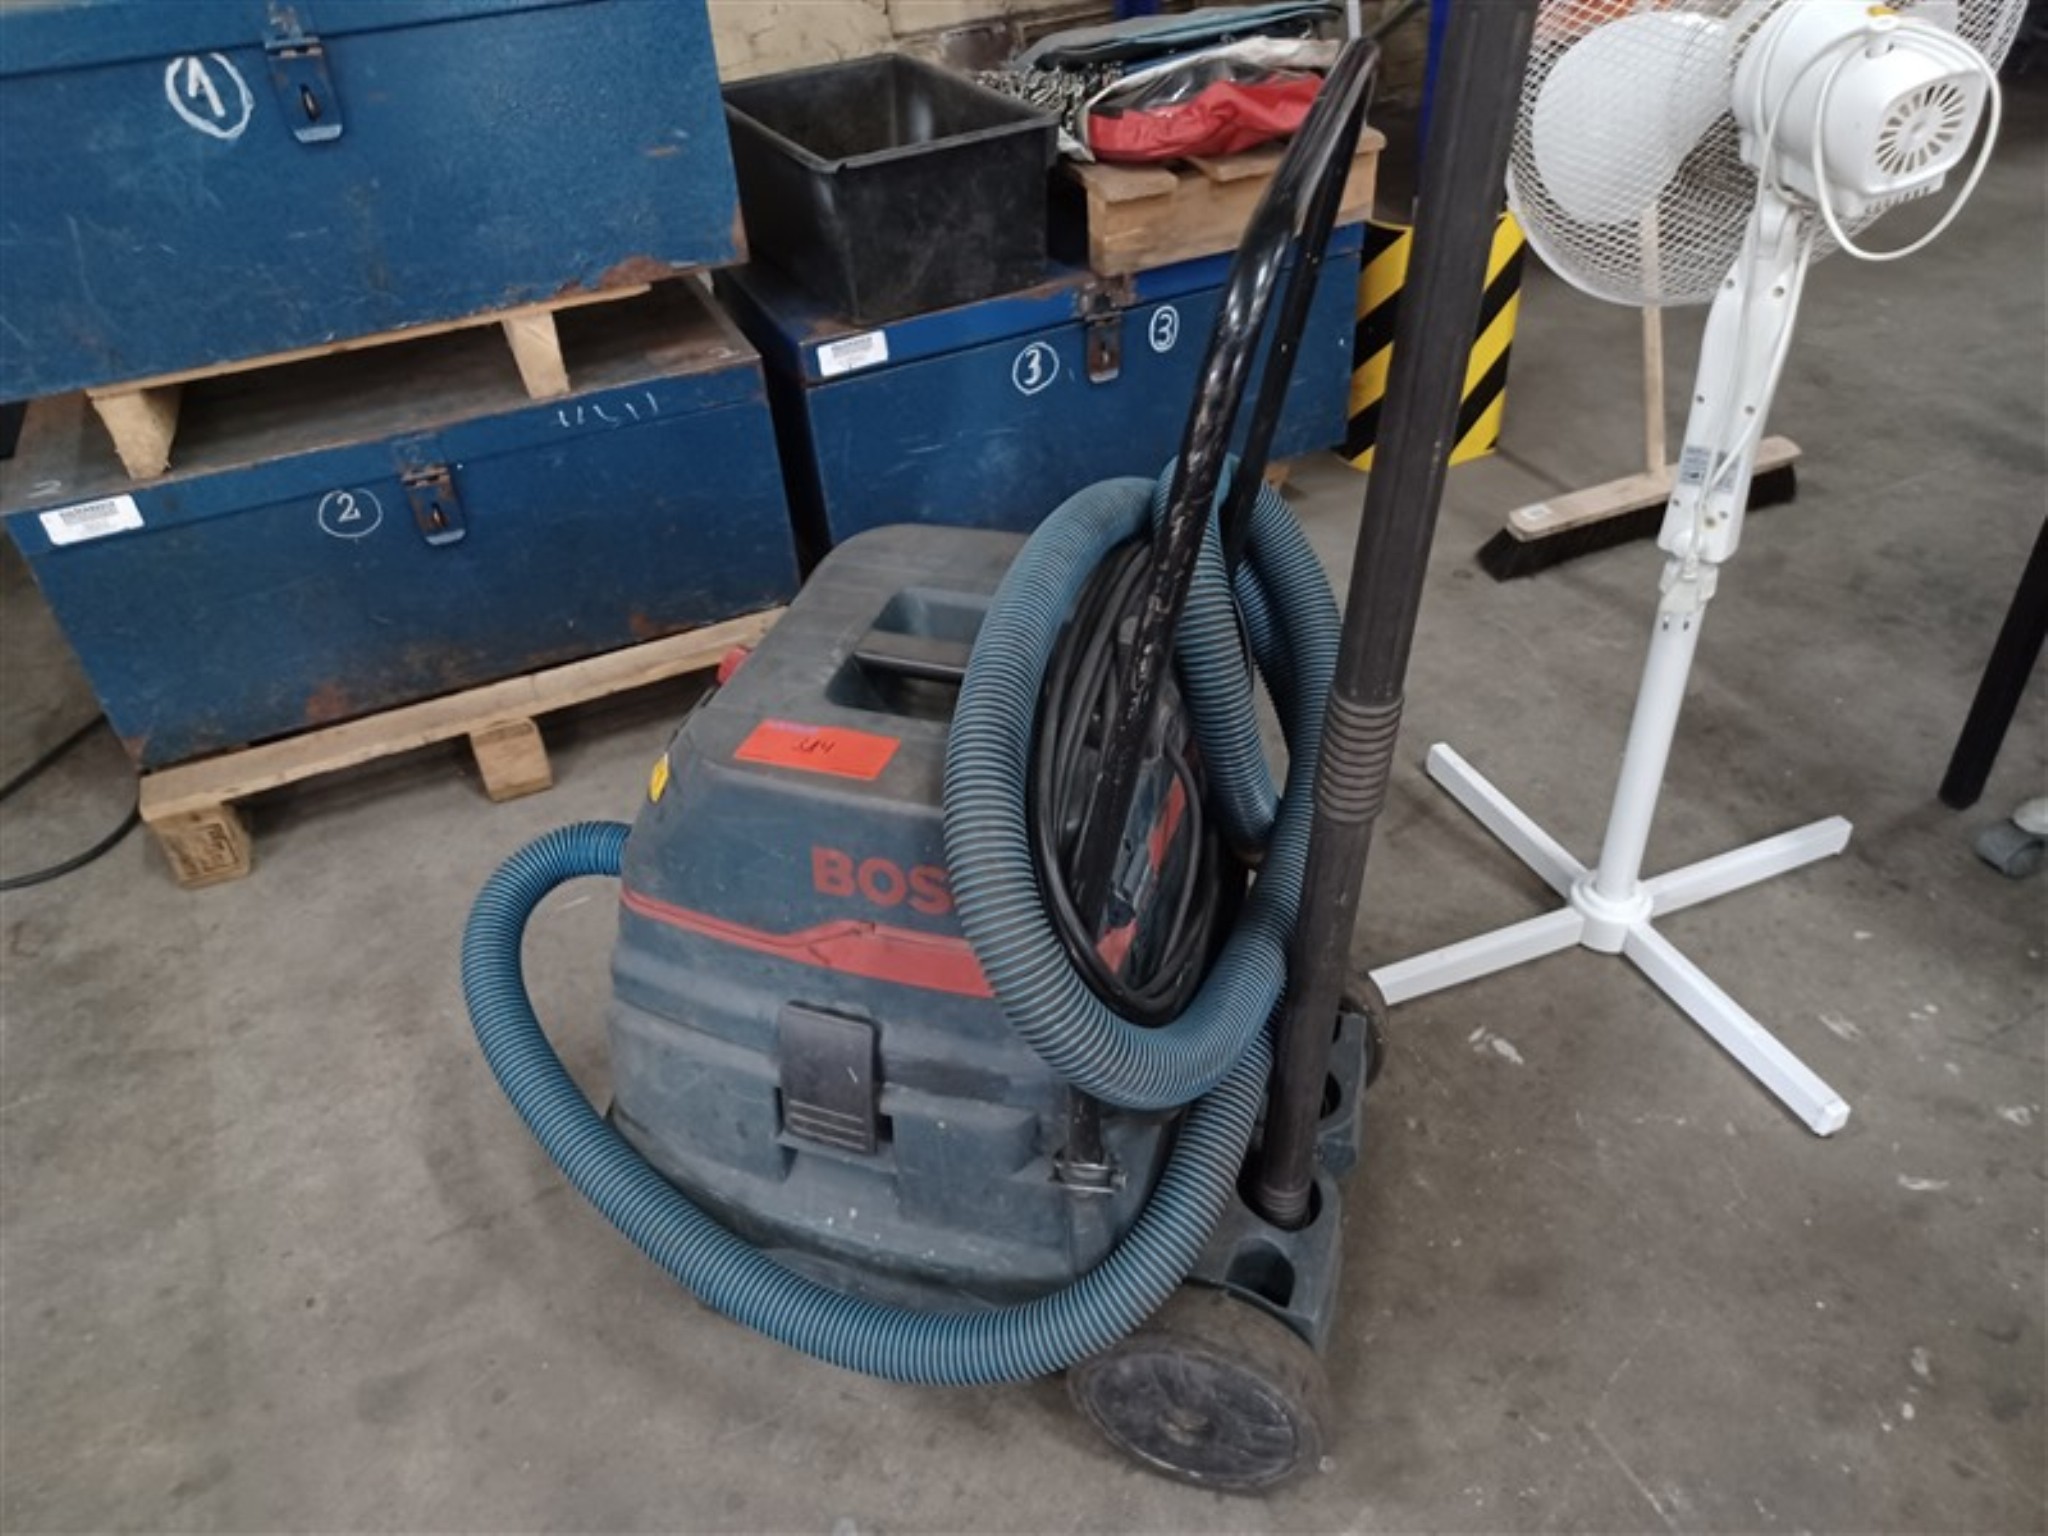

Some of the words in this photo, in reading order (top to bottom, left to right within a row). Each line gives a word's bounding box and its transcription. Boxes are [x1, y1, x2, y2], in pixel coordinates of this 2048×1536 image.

[187, 56, 226, 118] 1
[1157, 313, 1173, 348] 3
[1023, 348, 1043, 385] 3
[336, 492, 361, 522] 2
[811, 844, 956, 917] BOS
